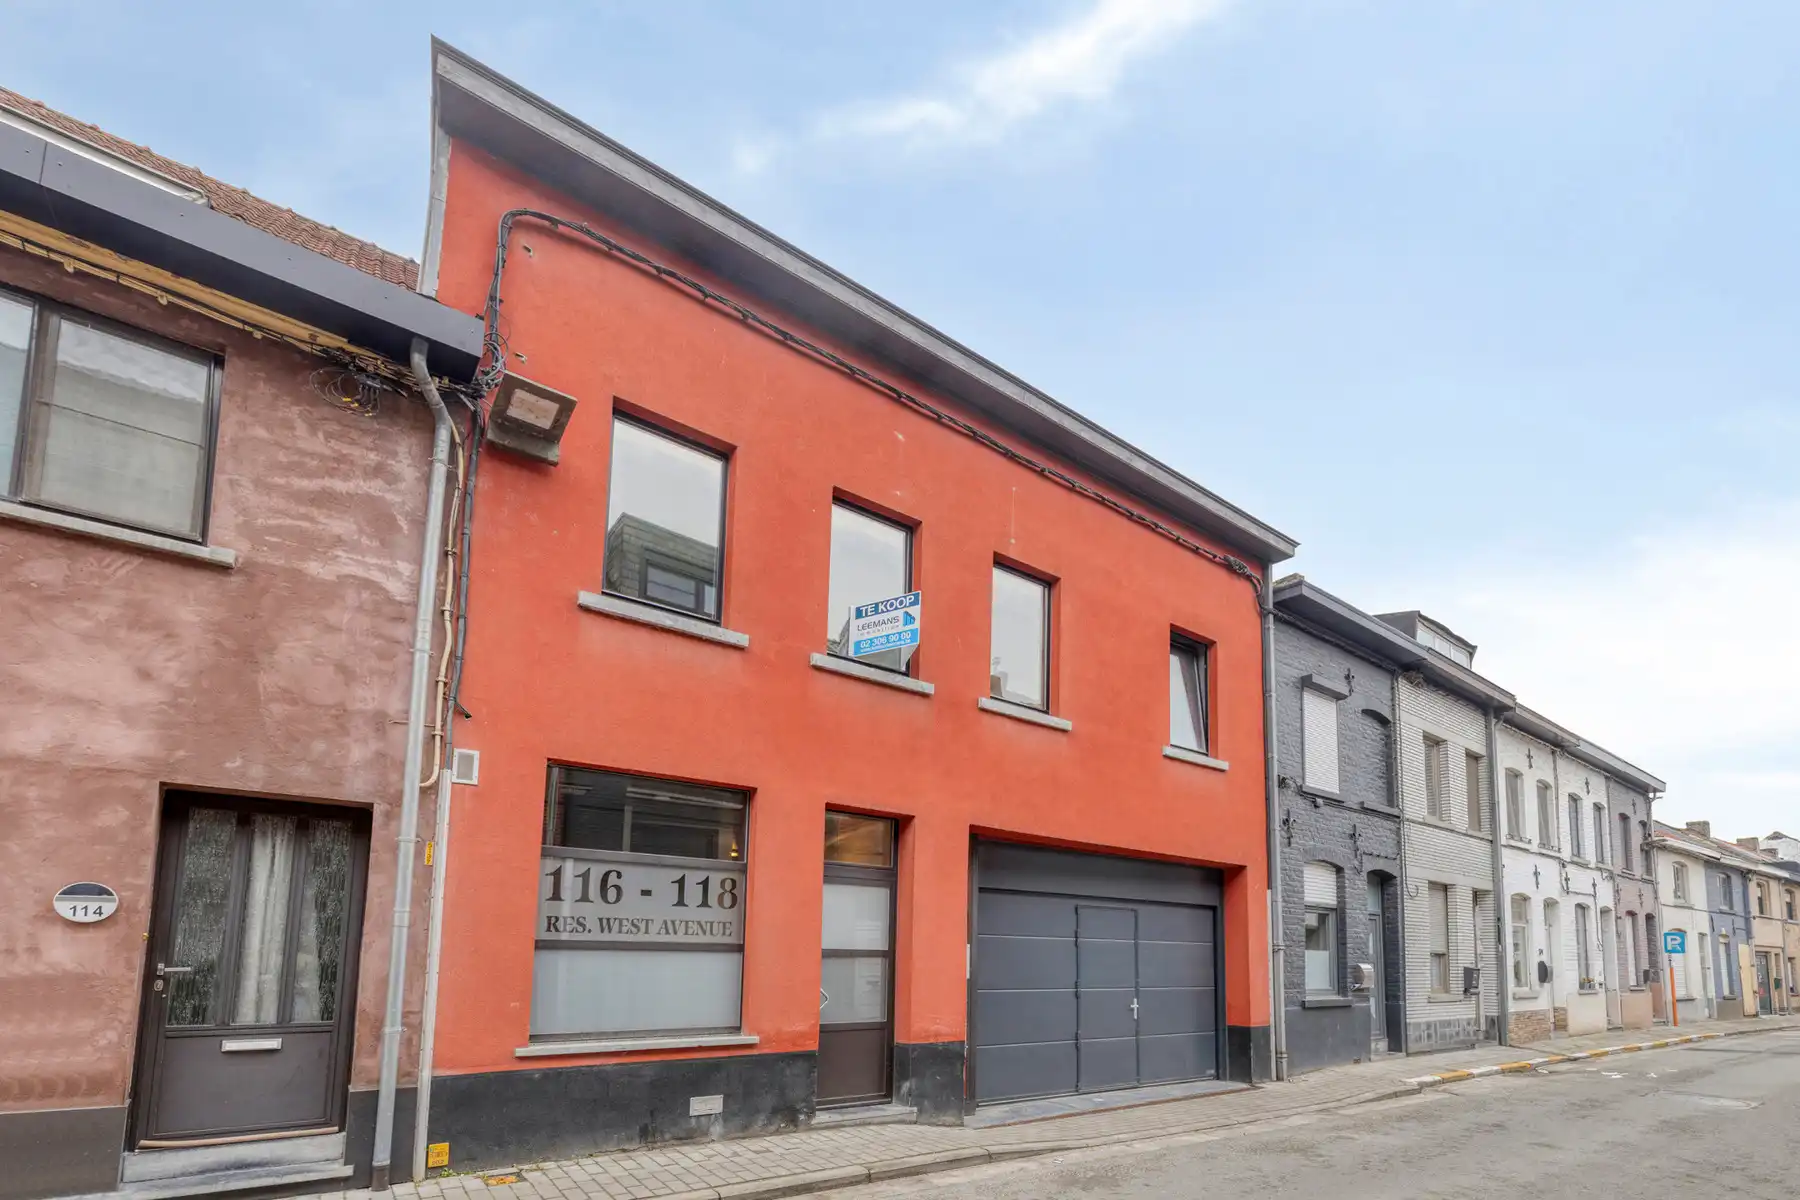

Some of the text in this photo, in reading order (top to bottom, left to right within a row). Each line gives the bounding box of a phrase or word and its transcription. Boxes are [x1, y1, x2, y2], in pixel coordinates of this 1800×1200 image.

[860, 595, 915, 617] TE KOOP
[857, 615, 900, 632] LEEMANS
[860, 640, 871, 649] 02
[888, 633, 899, 643] 90
[545, 864, 623, 905] 116
[670, 873, 738, 910] 118
[69, 905, 104, 917] 114
[545, 915, 732, 938] RES. WEST AVENUE
